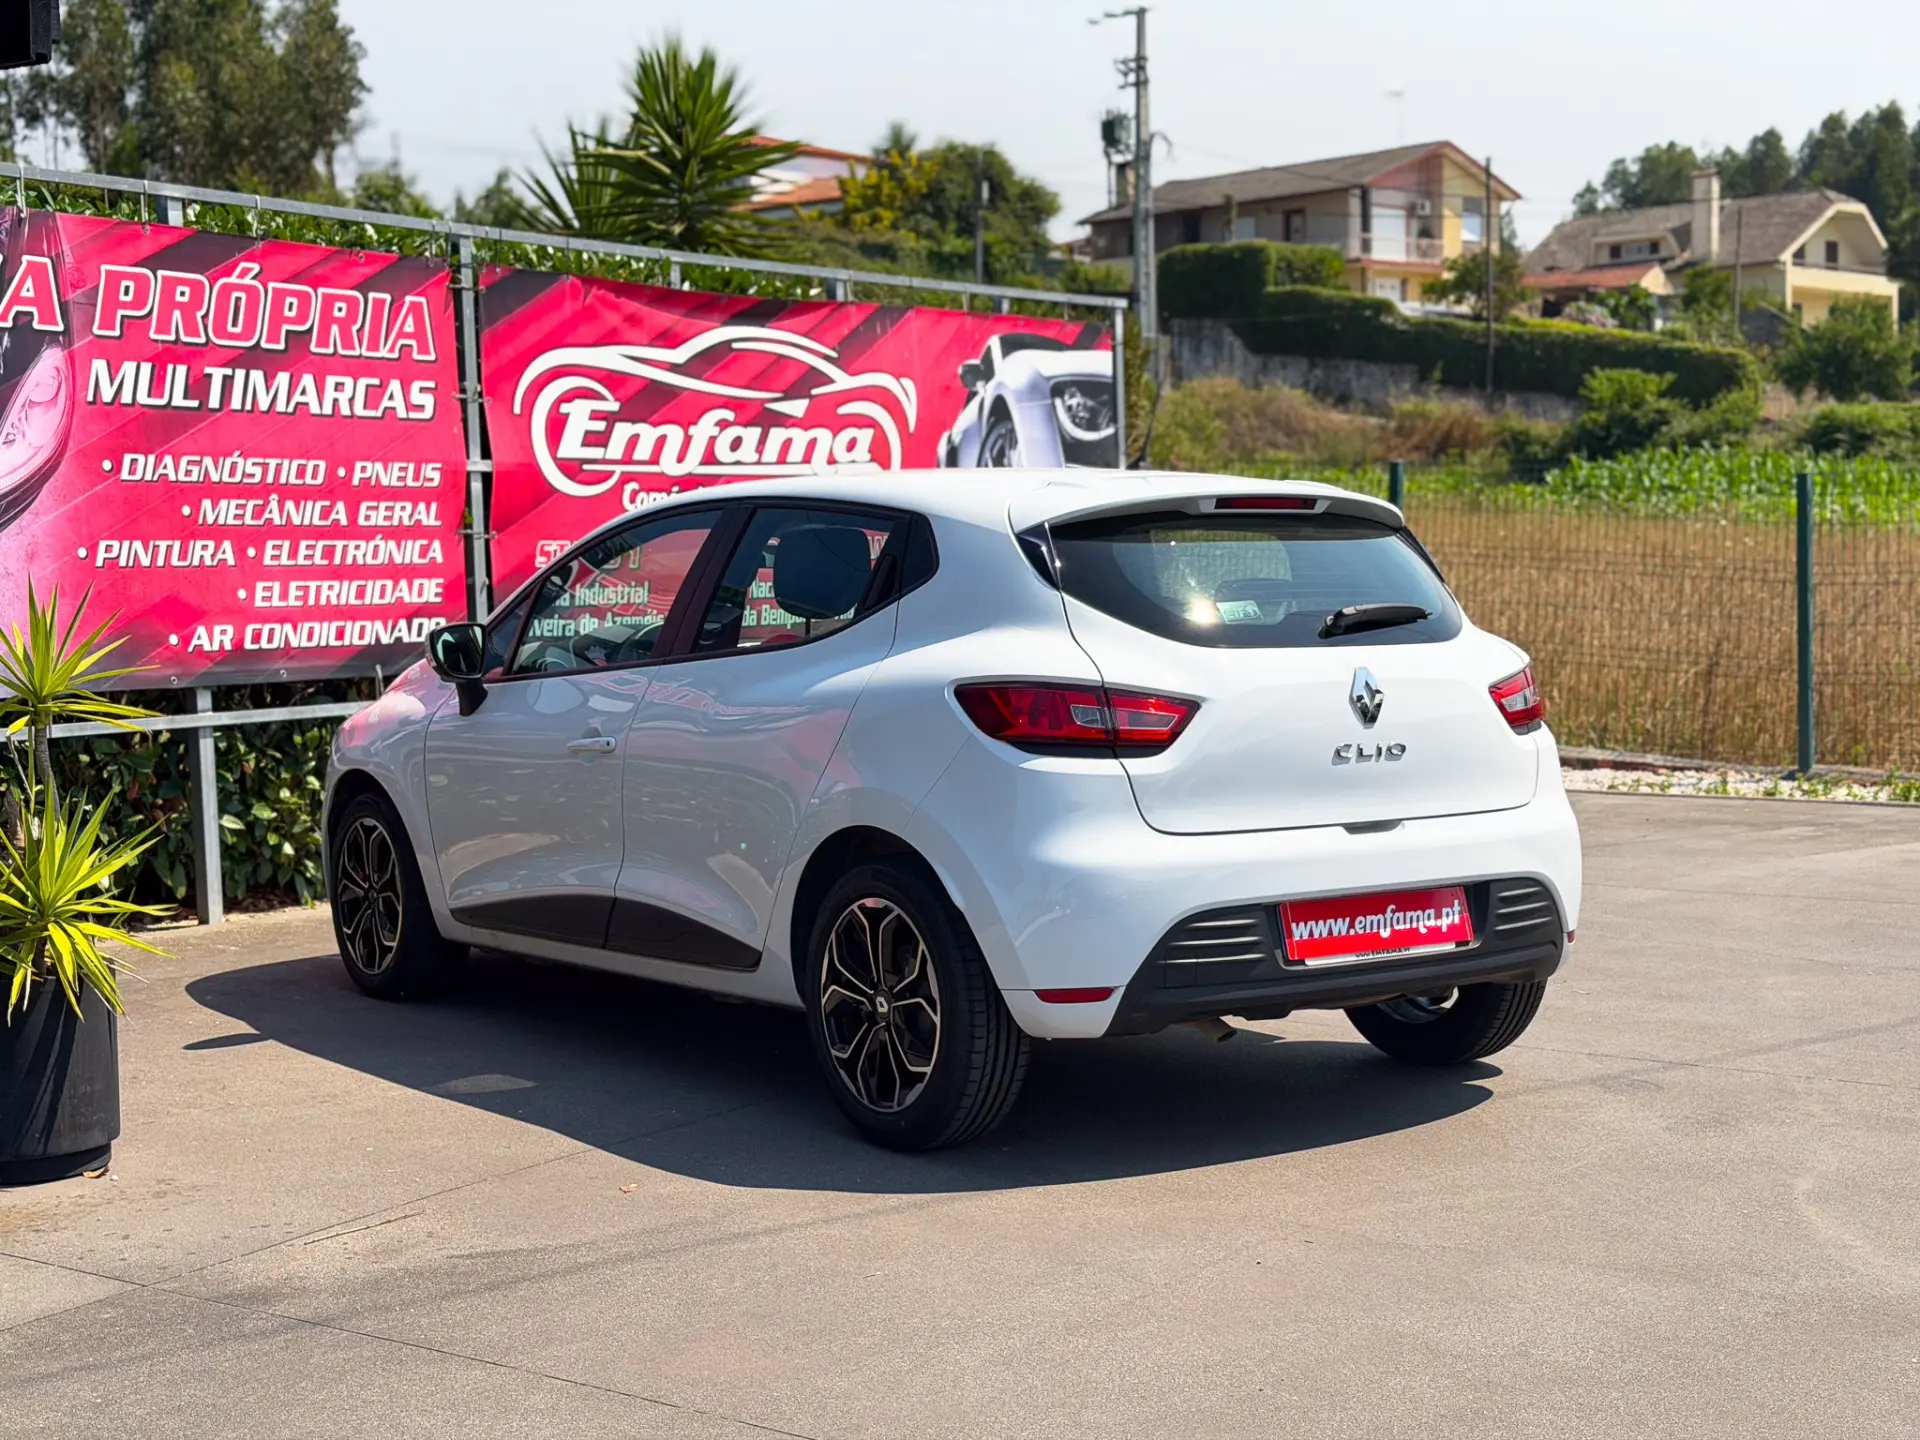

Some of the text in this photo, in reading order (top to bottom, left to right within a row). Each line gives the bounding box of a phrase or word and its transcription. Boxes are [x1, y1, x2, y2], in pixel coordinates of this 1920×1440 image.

[0, 253, 437, 361] A PRÓPRIA
[86, 358, 436, 420] MULTIMARCAS
[556, 398, 876, 477] Emfama
[120, 451, 441, 487] DIAGNÓSTICO PNEUS
[198, 493, 442, 527] MECÂNICA GERAL
[95, 534, 443, 567] PINTURA ELECTRÓNICA
[255, 578, 444, 607] ELETRICIDADE
[575, 581, 650, 606] Industrial
[188, 624, 234, 652] AR
[580, 612, 599, 635] de
[1331, 740, 1407, 766] CLIO
[1290, 899, 1461, 941] www.emfama.pt
